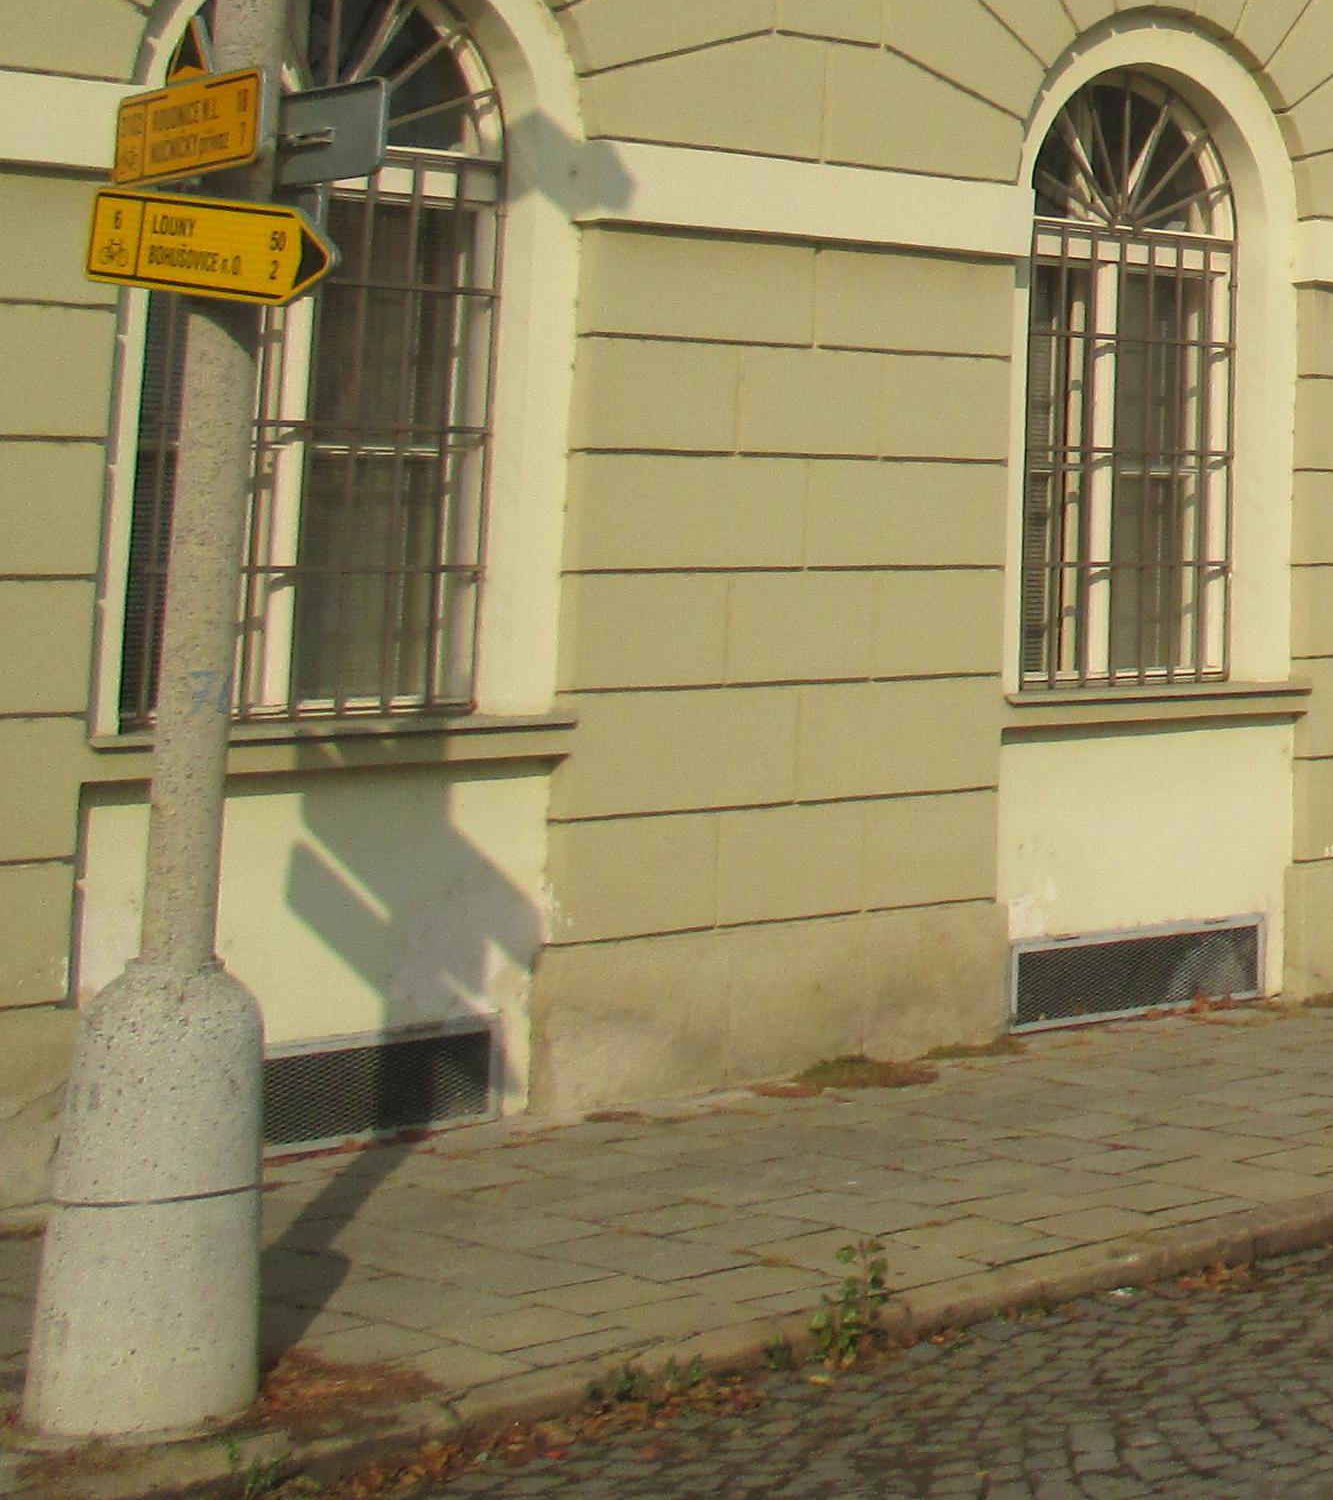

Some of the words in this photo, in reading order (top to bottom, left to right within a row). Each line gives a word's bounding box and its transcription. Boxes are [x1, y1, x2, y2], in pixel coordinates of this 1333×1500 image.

[113, 210, 123, 230] 6
[152, 214, 198, 238] LOUNY
[270, 231, 288, 252] 50
[148, 244, 219, 273] BOHUŠOVICE
[268, 259, 279, 280] 2
